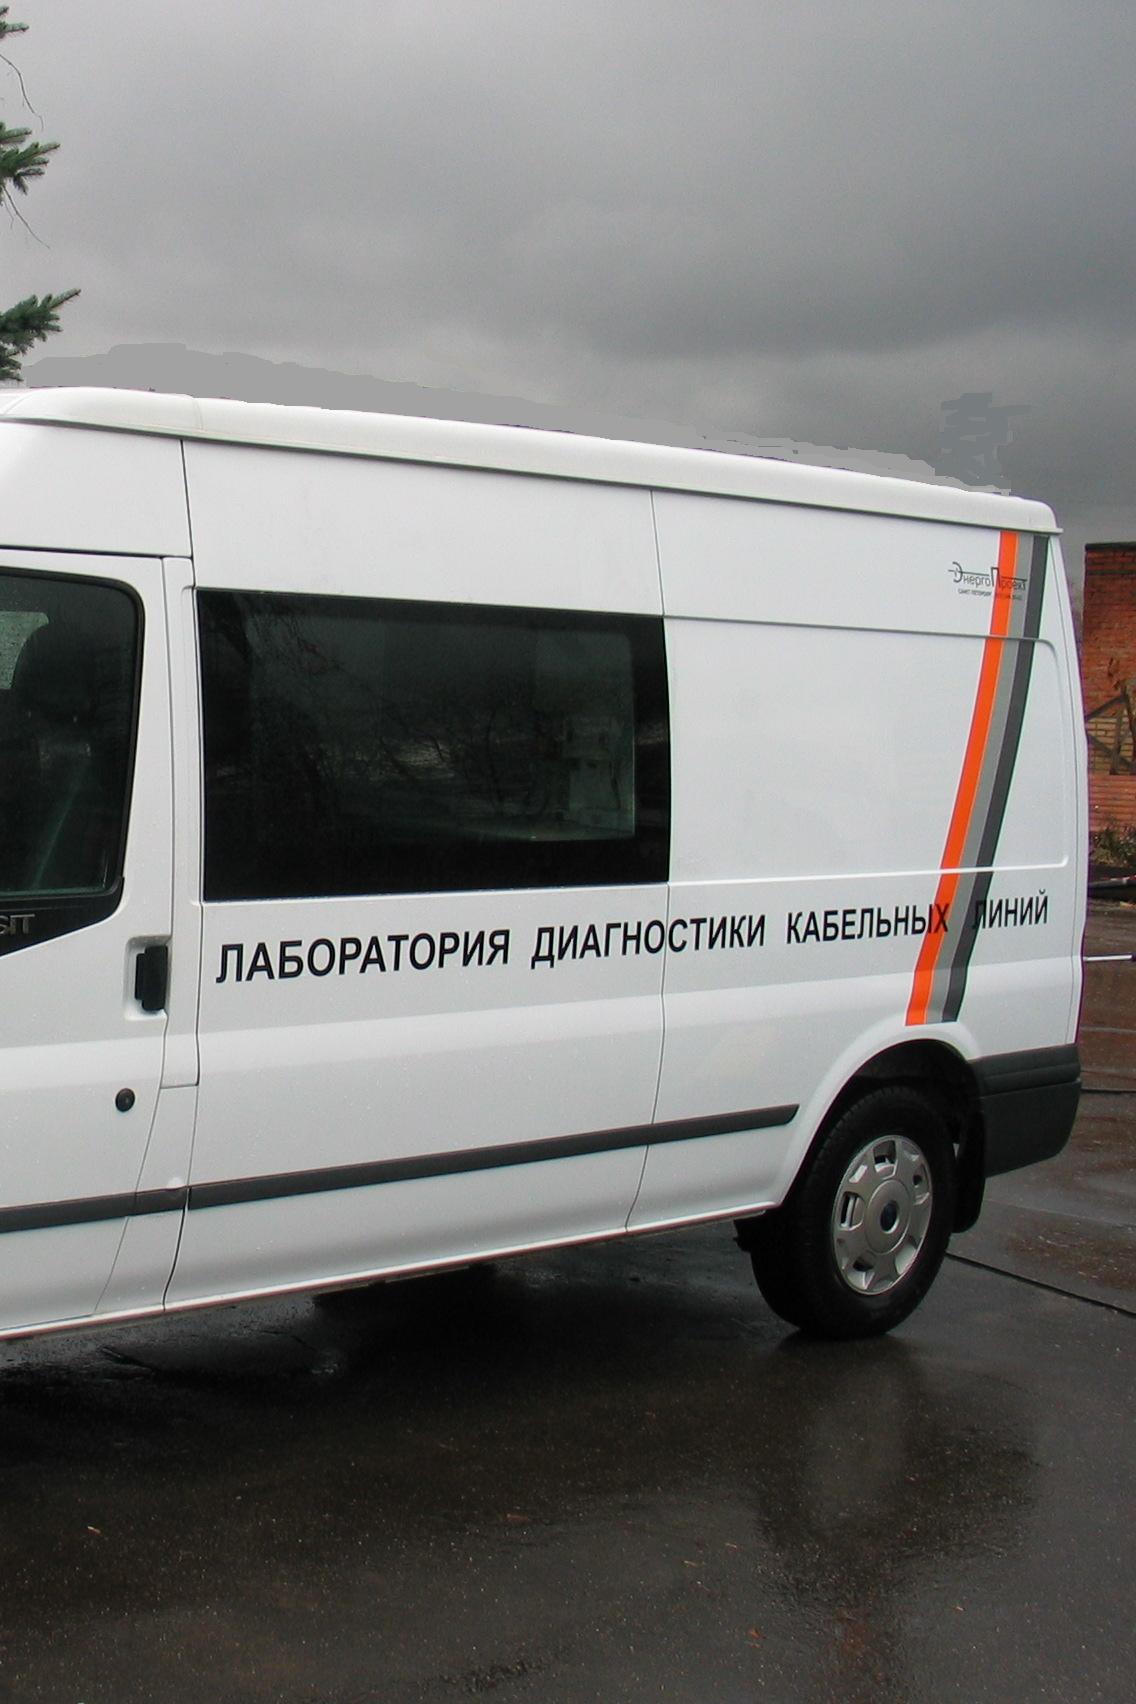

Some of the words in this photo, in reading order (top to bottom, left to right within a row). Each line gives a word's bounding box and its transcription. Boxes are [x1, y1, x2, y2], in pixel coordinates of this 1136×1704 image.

[215, 929, 510, 983] ЛАБОРАТОРИЯ
[530, 914, 766, 969] ДИАГНОСТИКИ
[786, 903, 950, 945] КАБЕЛЬНЫХ
[972, 888, 1049, 930] ЛИНИЙ
